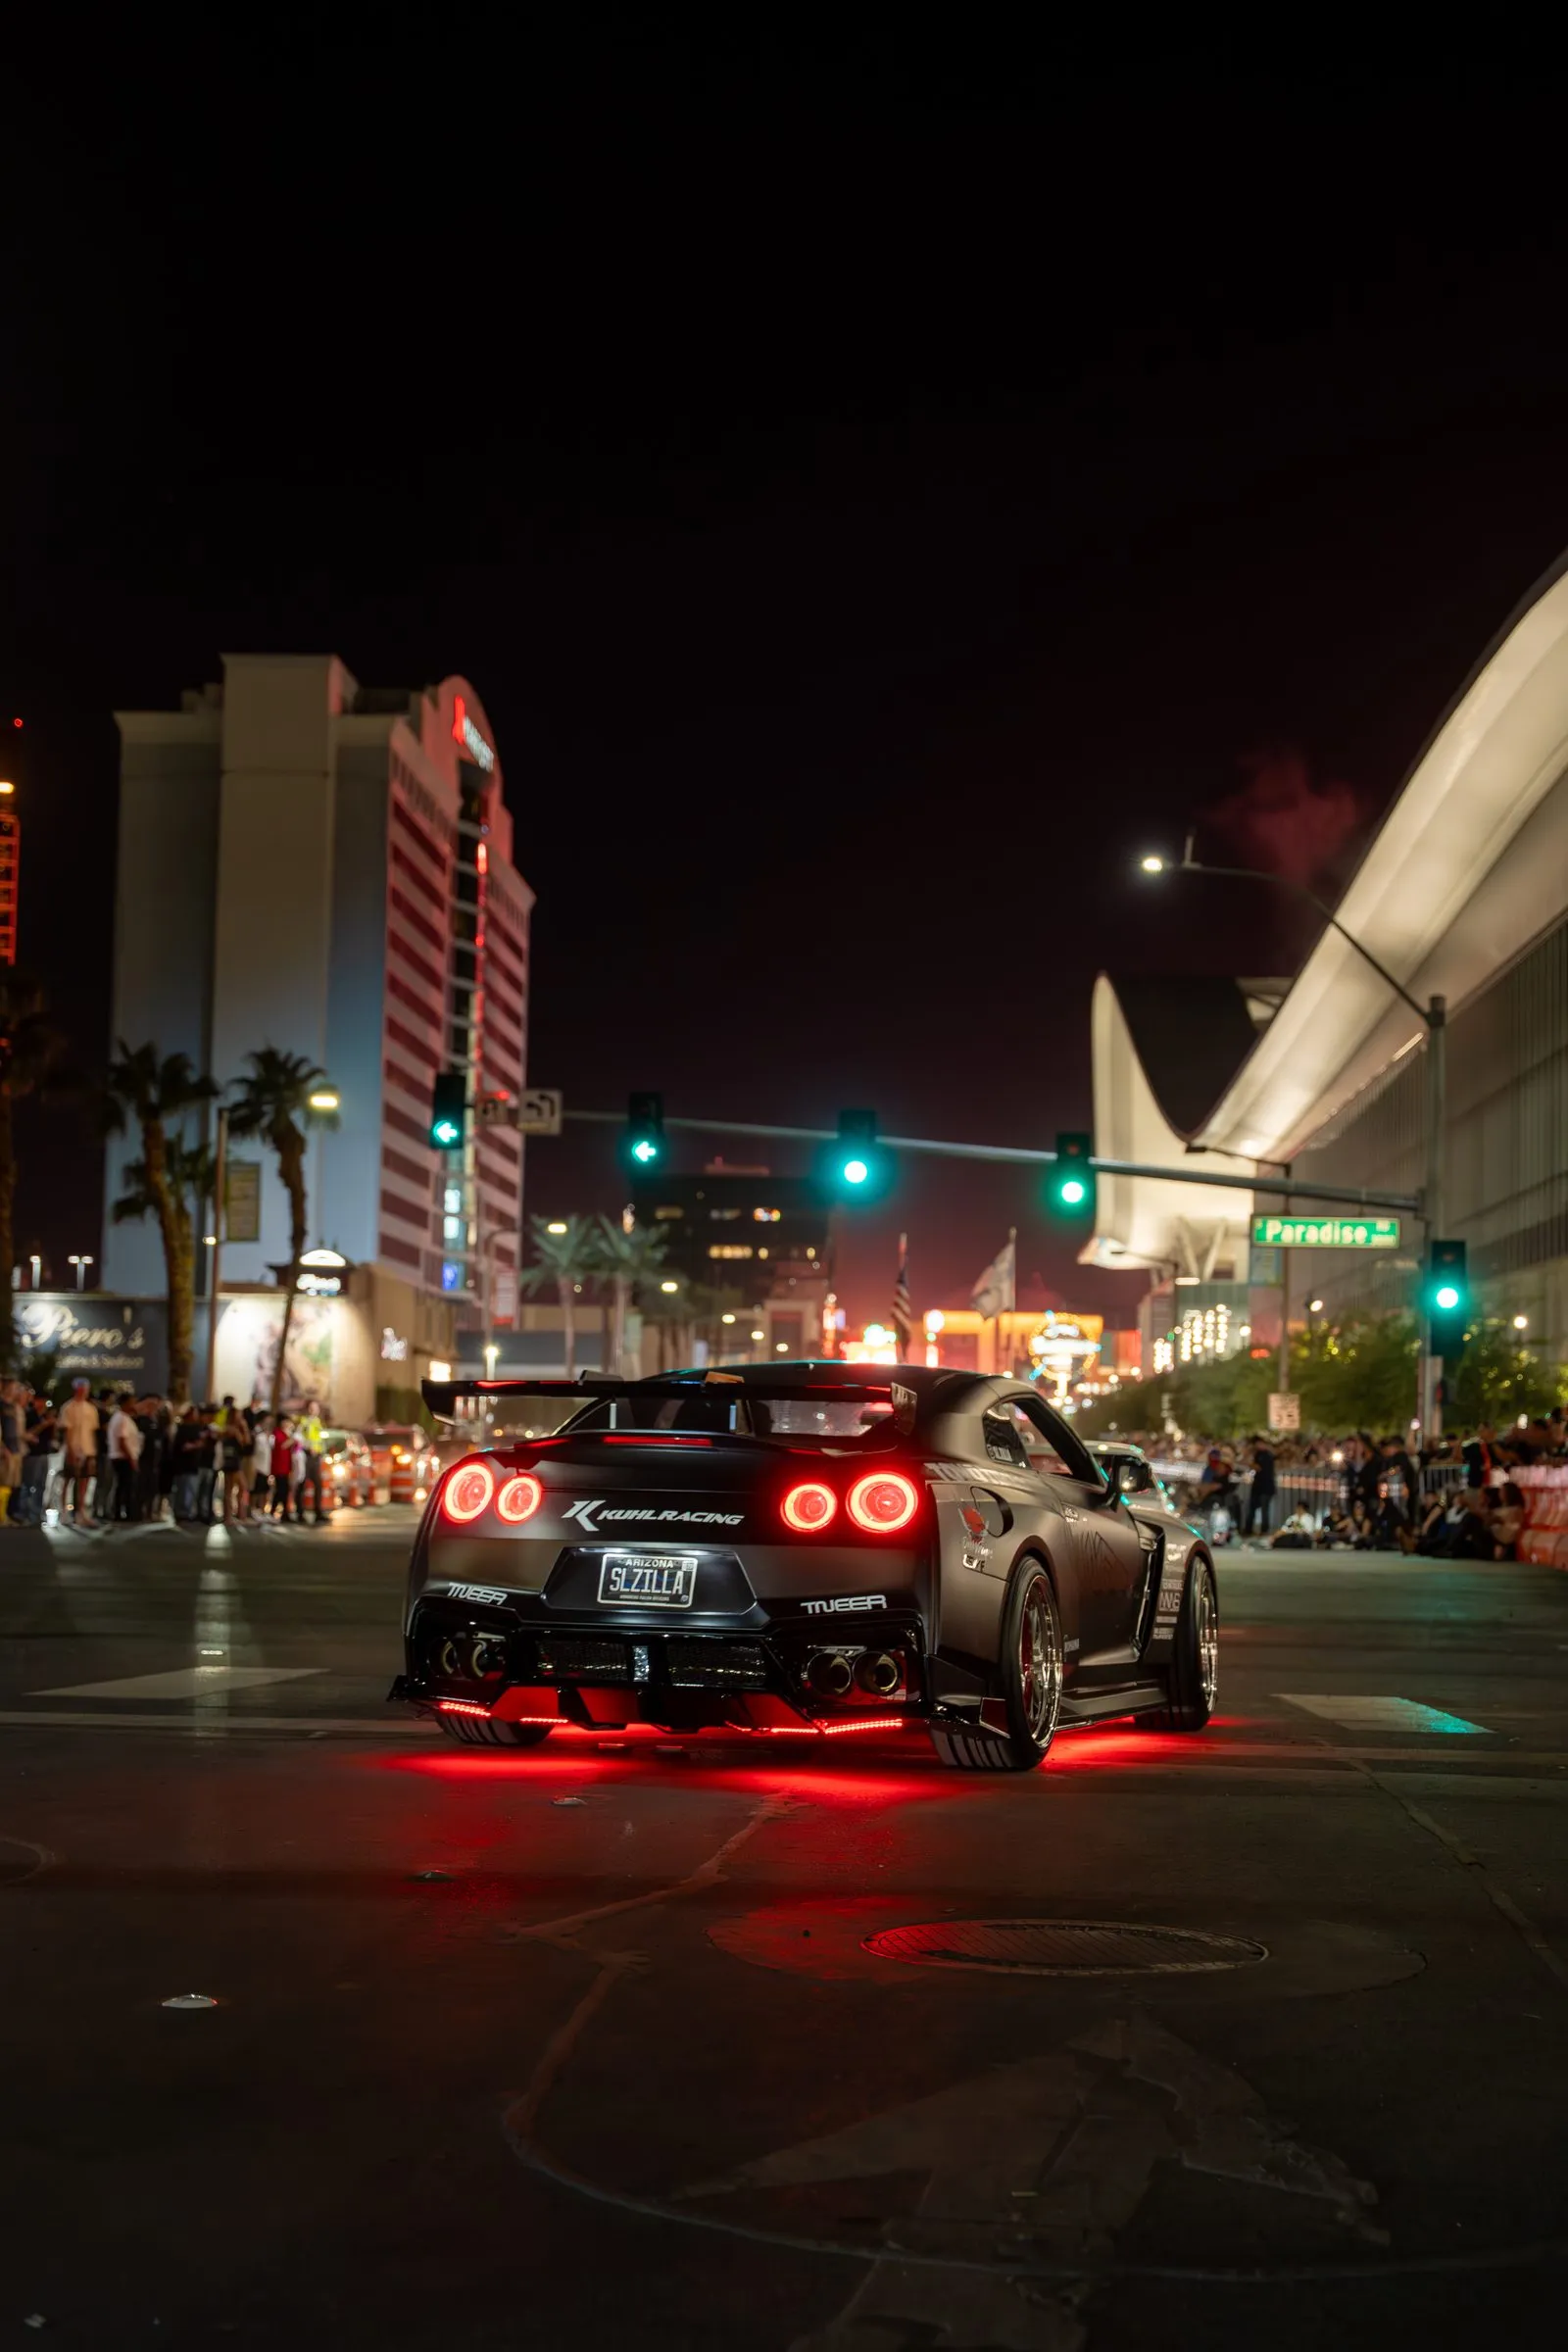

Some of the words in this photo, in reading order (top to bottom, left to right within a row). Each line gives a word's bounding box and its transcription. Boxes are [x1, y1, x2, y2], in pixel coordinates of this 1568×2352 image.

[1266, 1219, 1368, 1245] Paradise
[625, 1558, 674, 1568] ARIZONA
[610, 1567, 684, 1594] SLZILLA
